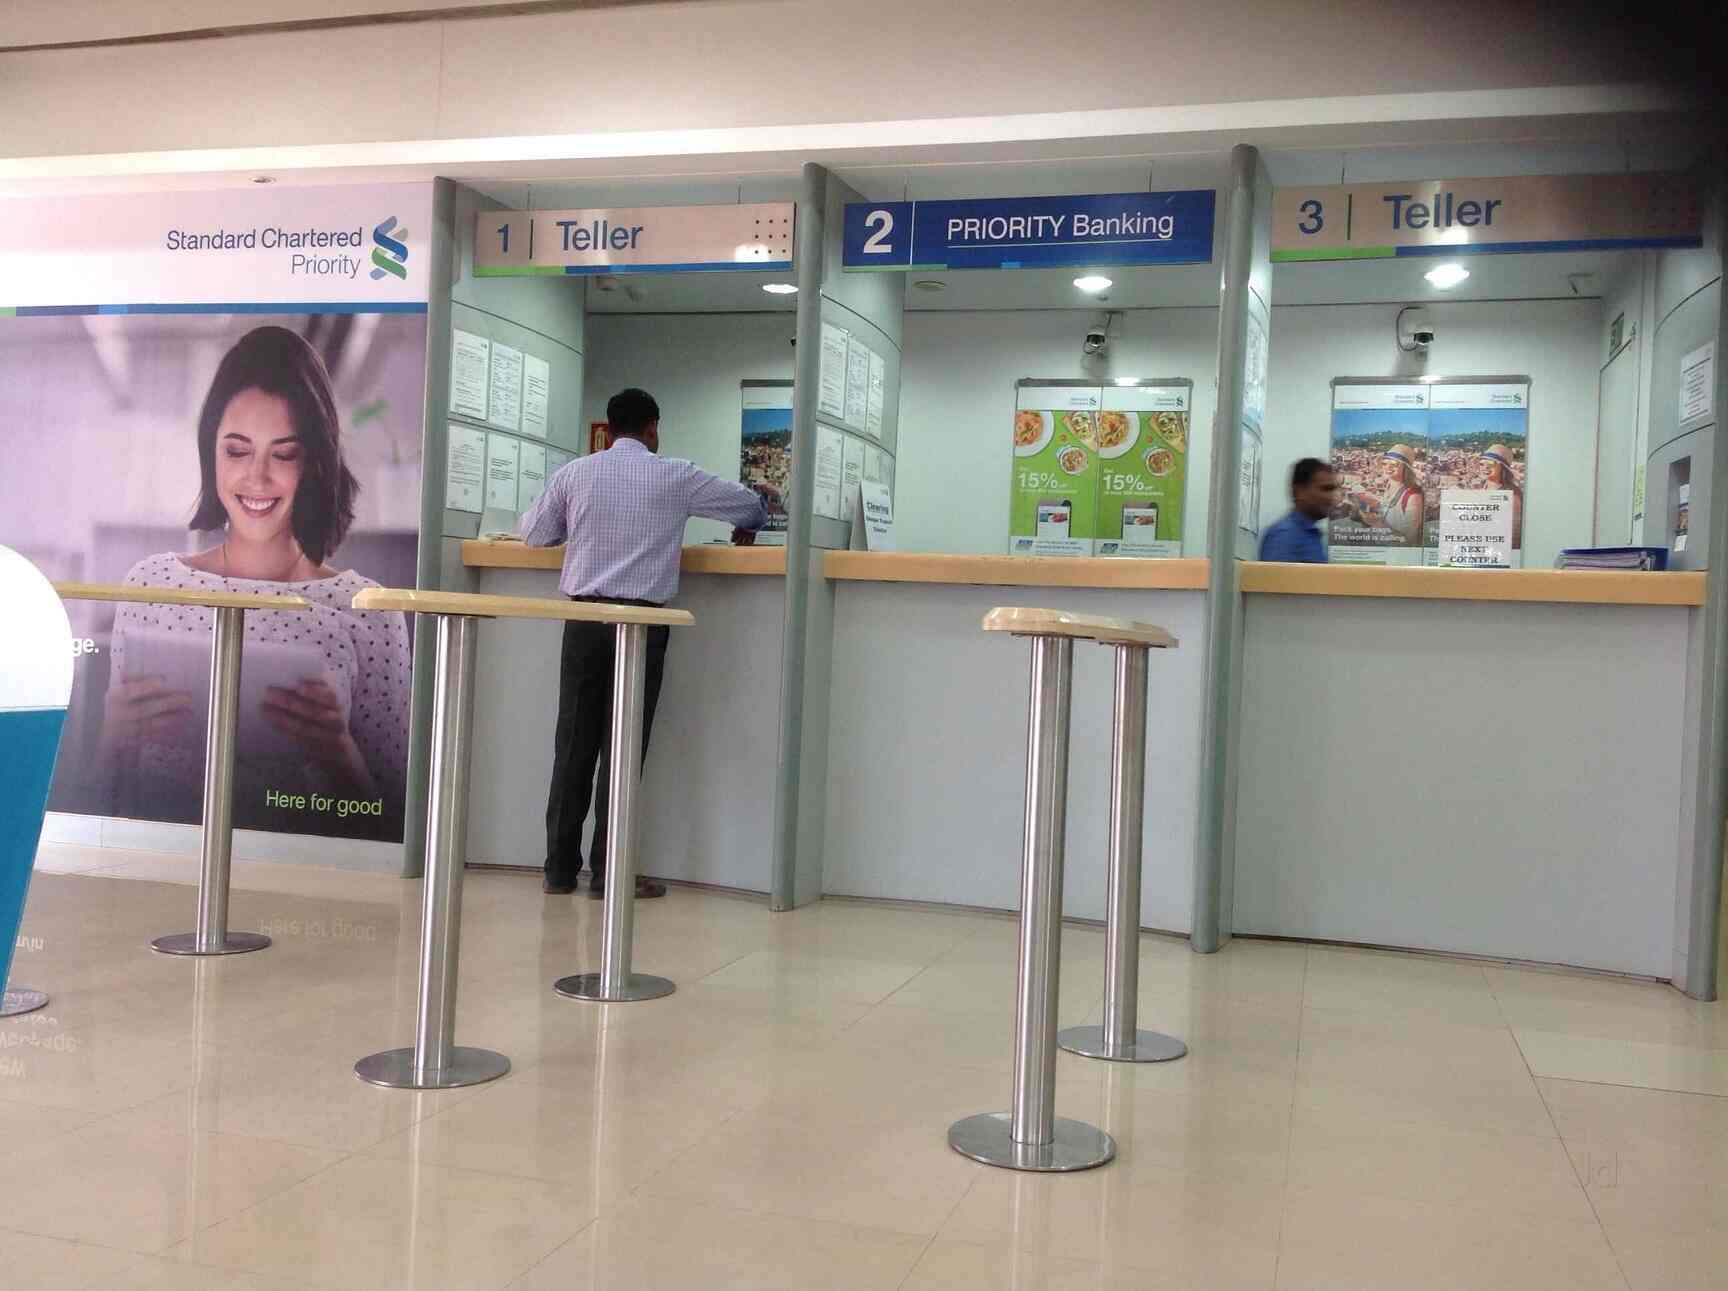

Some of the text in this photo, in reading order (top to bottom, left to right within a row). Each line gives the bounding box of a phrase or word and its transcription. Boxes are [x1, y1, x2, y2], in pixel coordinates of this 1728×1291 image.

[1298, 192, 1502, 235] 3 Teller
[166, 226, 362, 250] Standard Chartered
[496, 219, 644, 253] 1 Teller
[863, 210, 1174, 254] 2 PRIORITY Banking
[291, 253, 361, 279] Priority
[1018, 471, 1058, 489] 15%
[1103, 473, 1145, 491] 15%
[1451, 503, 1501, 511] COUNTER
[1444, 535, 1483, 543] PLEASE
[1485, 535, 1505, 543] USE
[1449, 556, 1499, 564] COUNTER
[265, 789, 383, 817] Here for good
